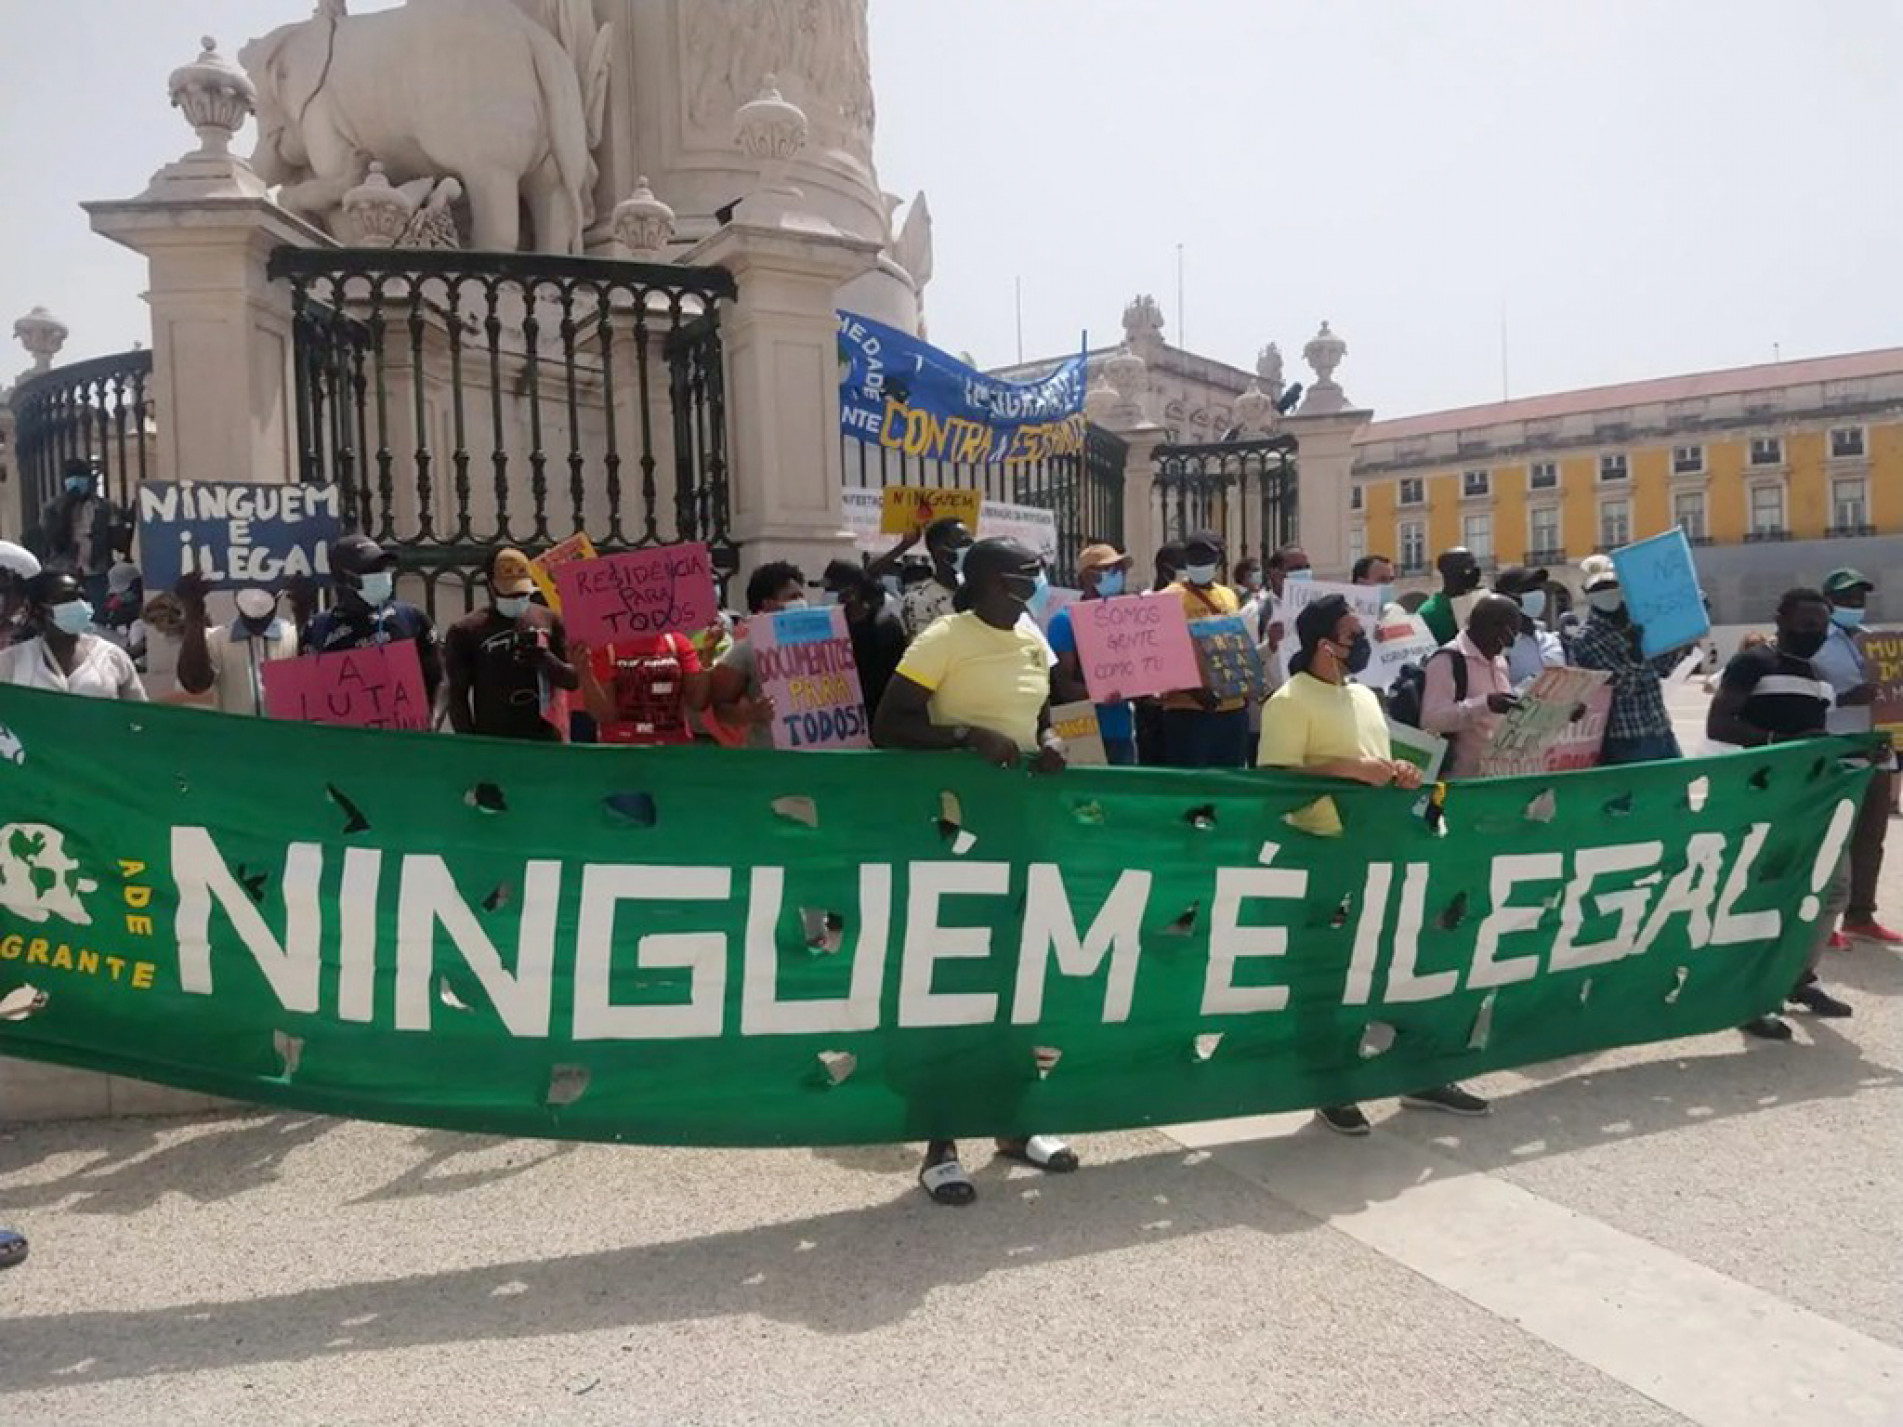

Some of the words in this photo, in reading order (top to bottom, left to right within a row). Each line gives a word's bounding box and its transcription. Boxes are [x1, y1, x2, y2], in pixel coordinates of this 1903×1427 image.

[880, 396, 994, 464] CONTRA
[618, 586, 670, 615] PARA
[1094, 605, 1161, 627] SOMOS
[601, 601, 696, 634] TODOS
[1106, 629, 1159, 651] GENTE
[338, 655, 366, 686] A
[1094, 661, 1134, 681] COMO
[788, 674, 853, 713] PARA
[782, 703, 867, 746] TODOS!
[170, 826, 1153, 1040] NINGUÉM
[1200, 841, 1309, 1016] É
[0, 934, 156, 989] GRANTE
